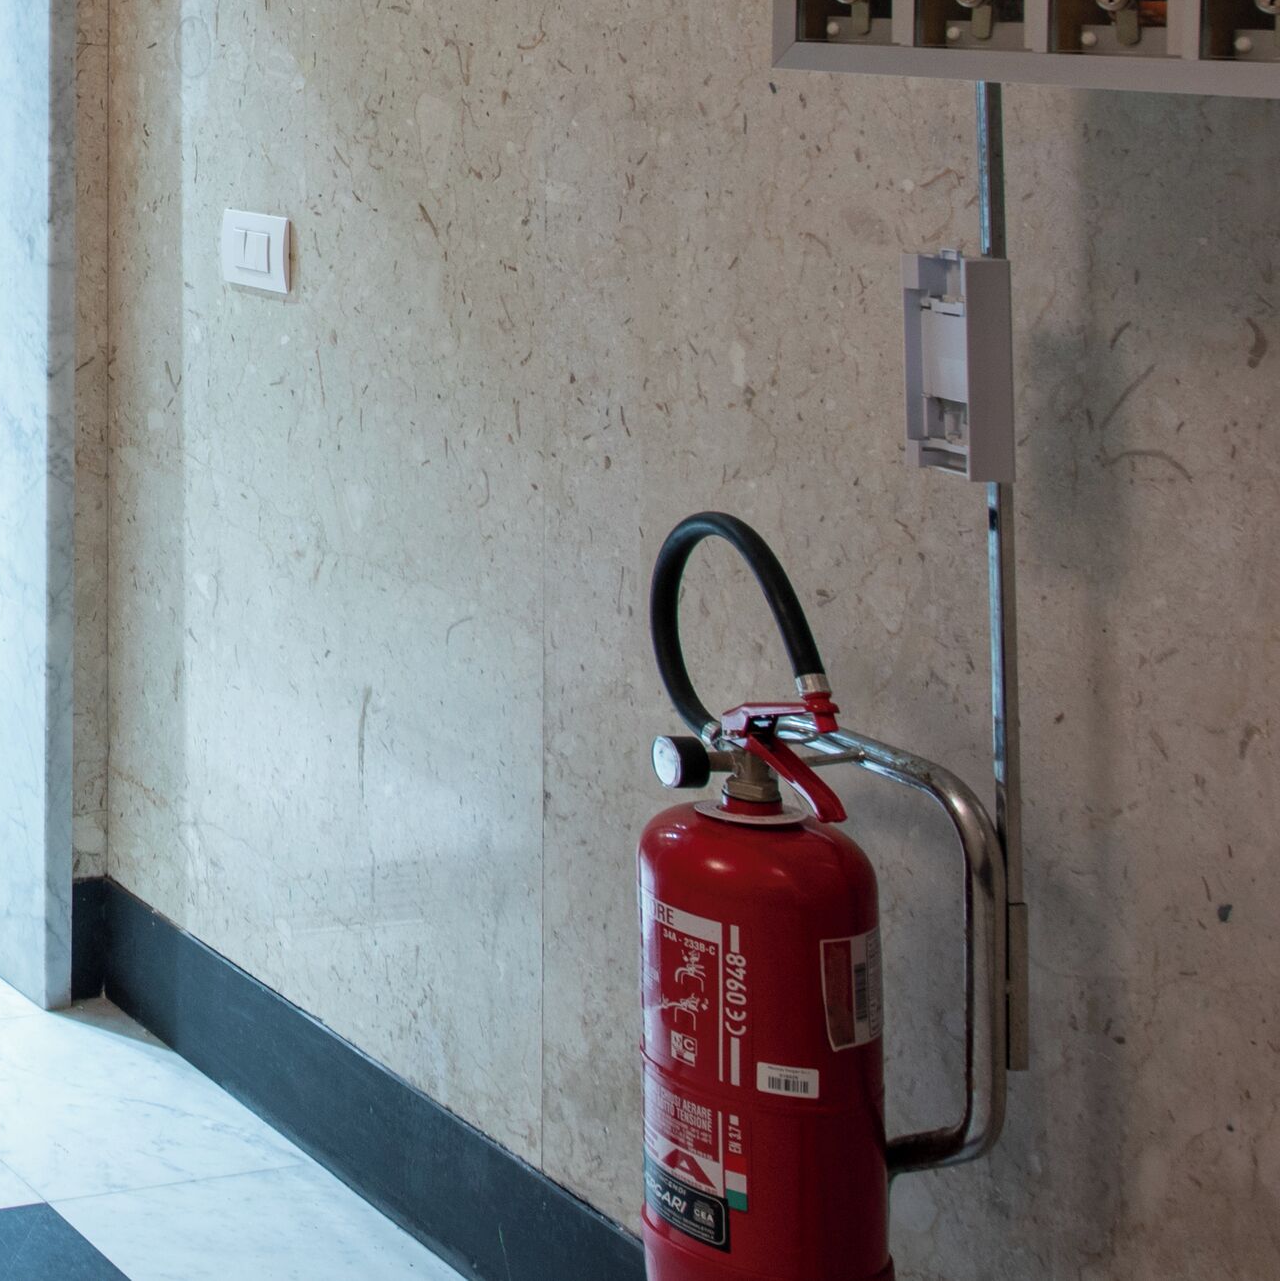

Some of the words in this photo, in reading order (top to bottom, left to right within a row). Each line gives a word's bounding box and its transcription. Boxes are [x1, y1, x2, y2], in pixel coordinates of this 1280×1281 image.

[724, 952, 748, 1006] 0948
[676, 1107, 713, 1133] TENSIONE
[682, 1098, 713, 1121] AERARE
[694, 1208, 714, 1223] CEA
